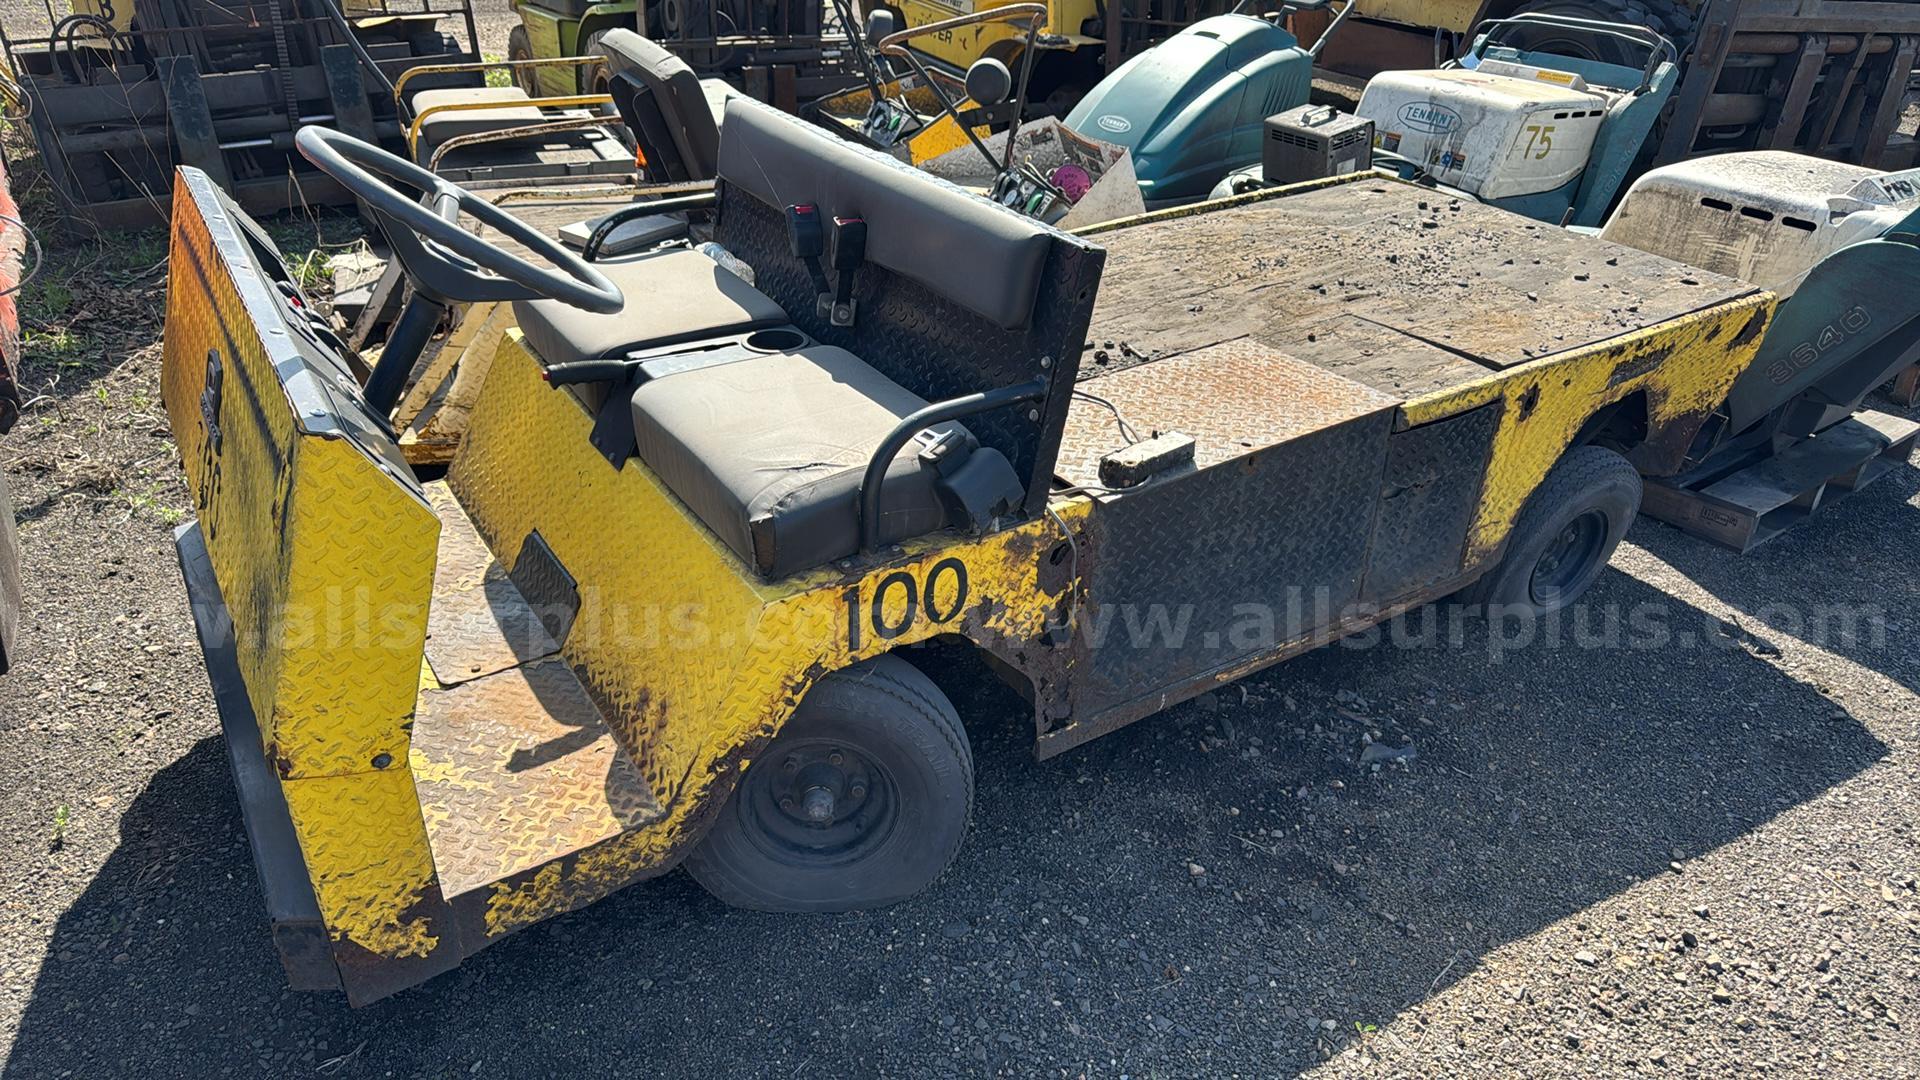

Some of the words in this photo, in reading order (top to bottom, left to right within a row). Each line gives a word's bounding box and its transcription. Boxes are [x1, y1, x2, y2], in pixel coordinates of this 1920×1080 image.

[1405, 106, 1456, 130] TENNANT
[1524, 125, 1556, 160] 75
[1767, 305, 1872, 385] 3640
[842, 557, 968, 653] 100
